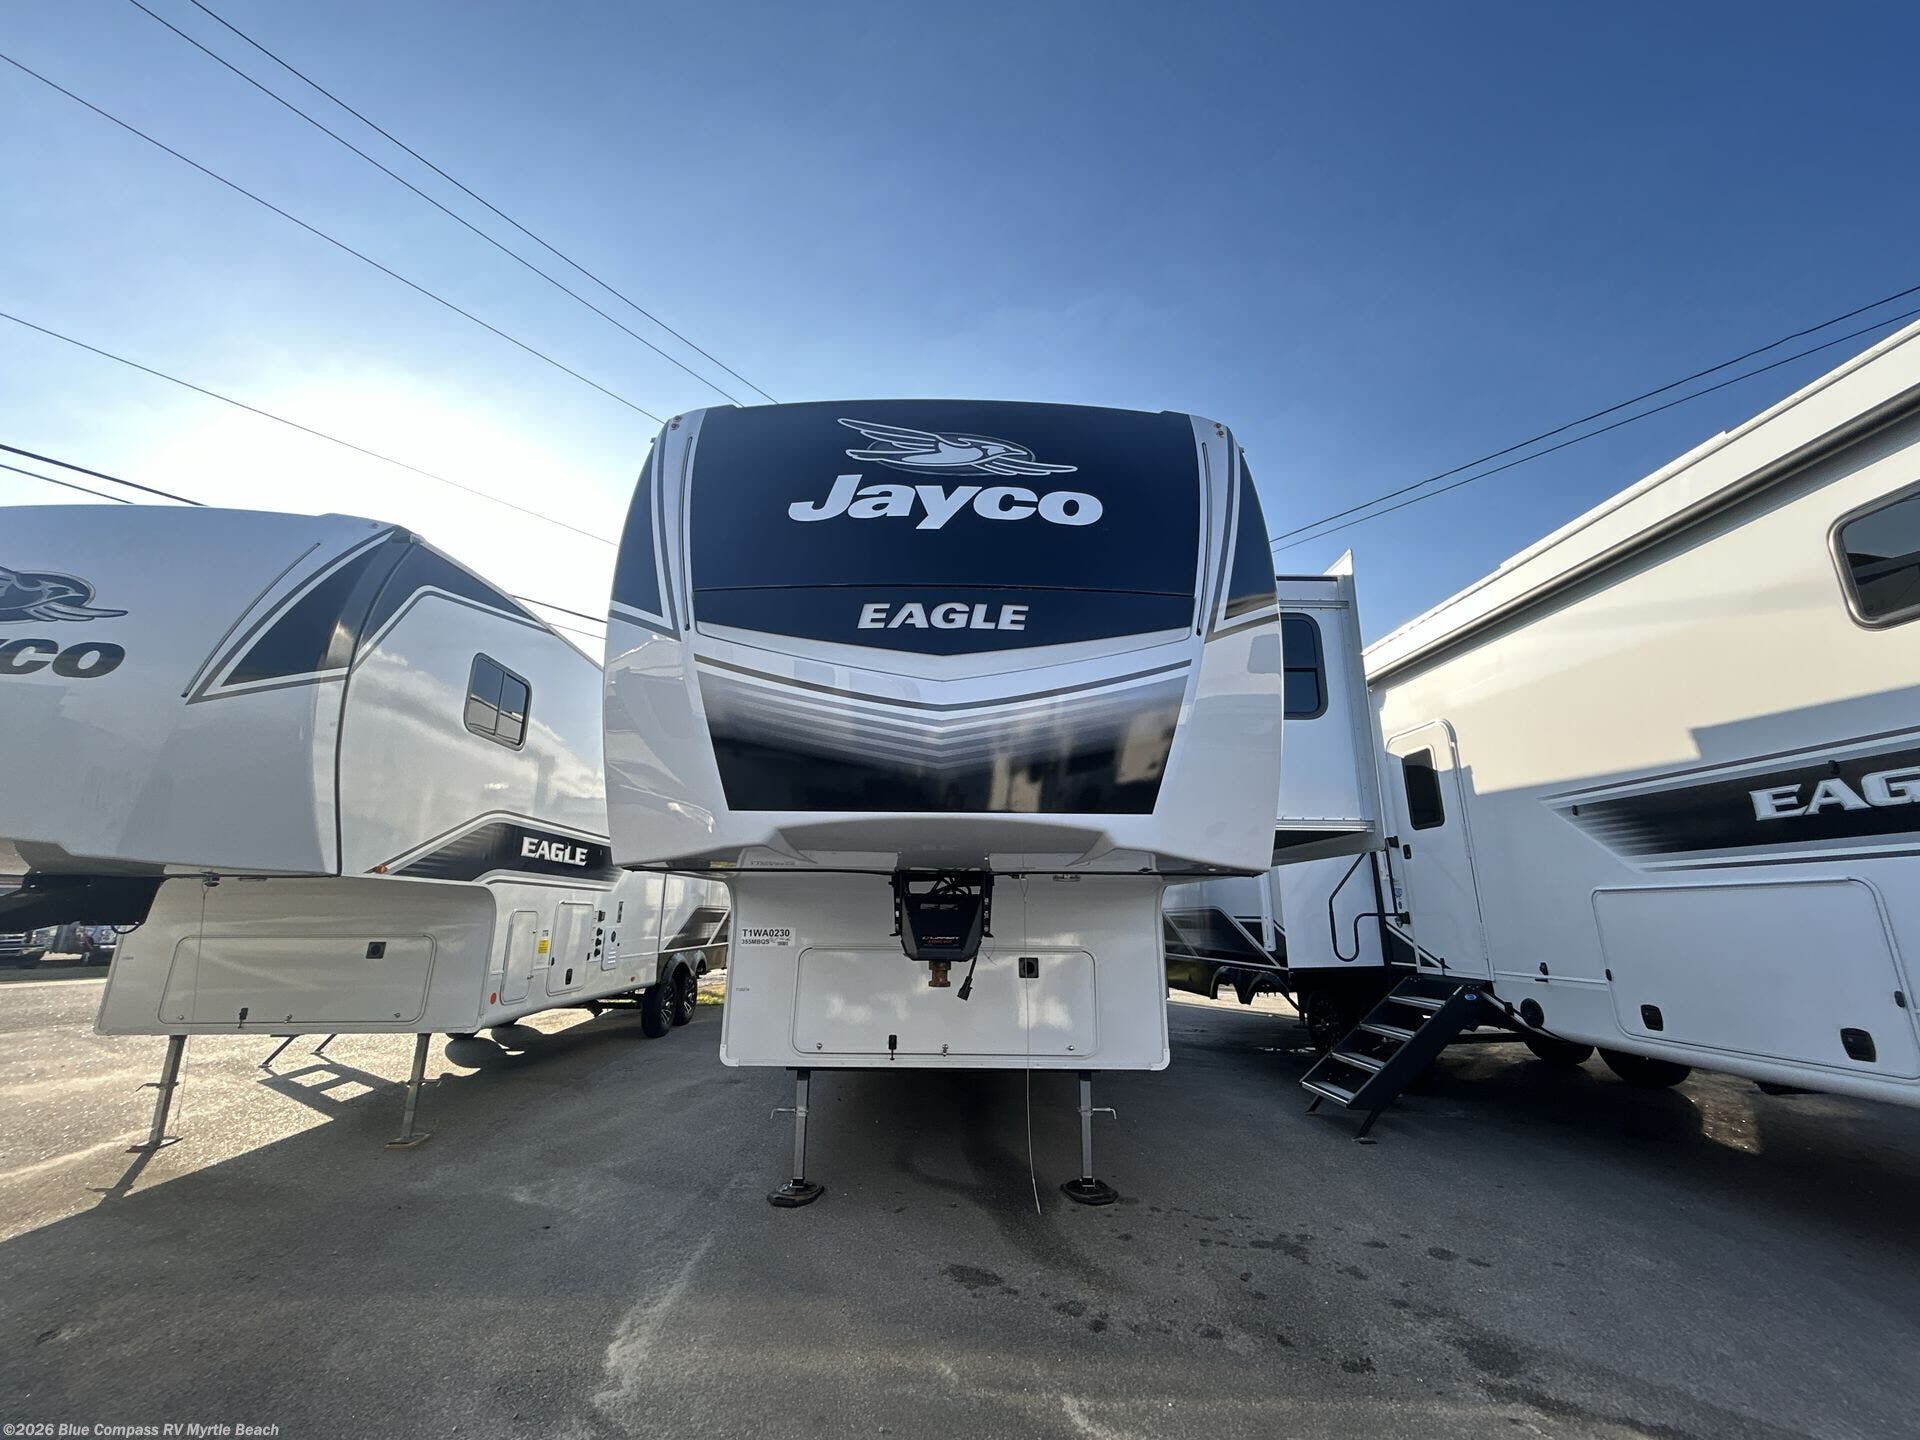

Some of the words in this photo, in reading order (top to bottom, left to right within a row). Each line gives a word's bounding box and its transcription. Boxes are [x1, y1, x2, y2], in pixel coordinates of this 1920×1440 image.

[788, 474, 1103, 530] Jayco
[857, 602, 1030, 631] EAGLE
[520, 836, 588, 867] EAGLE
[742, 928, 790, 937] T1WA0230
